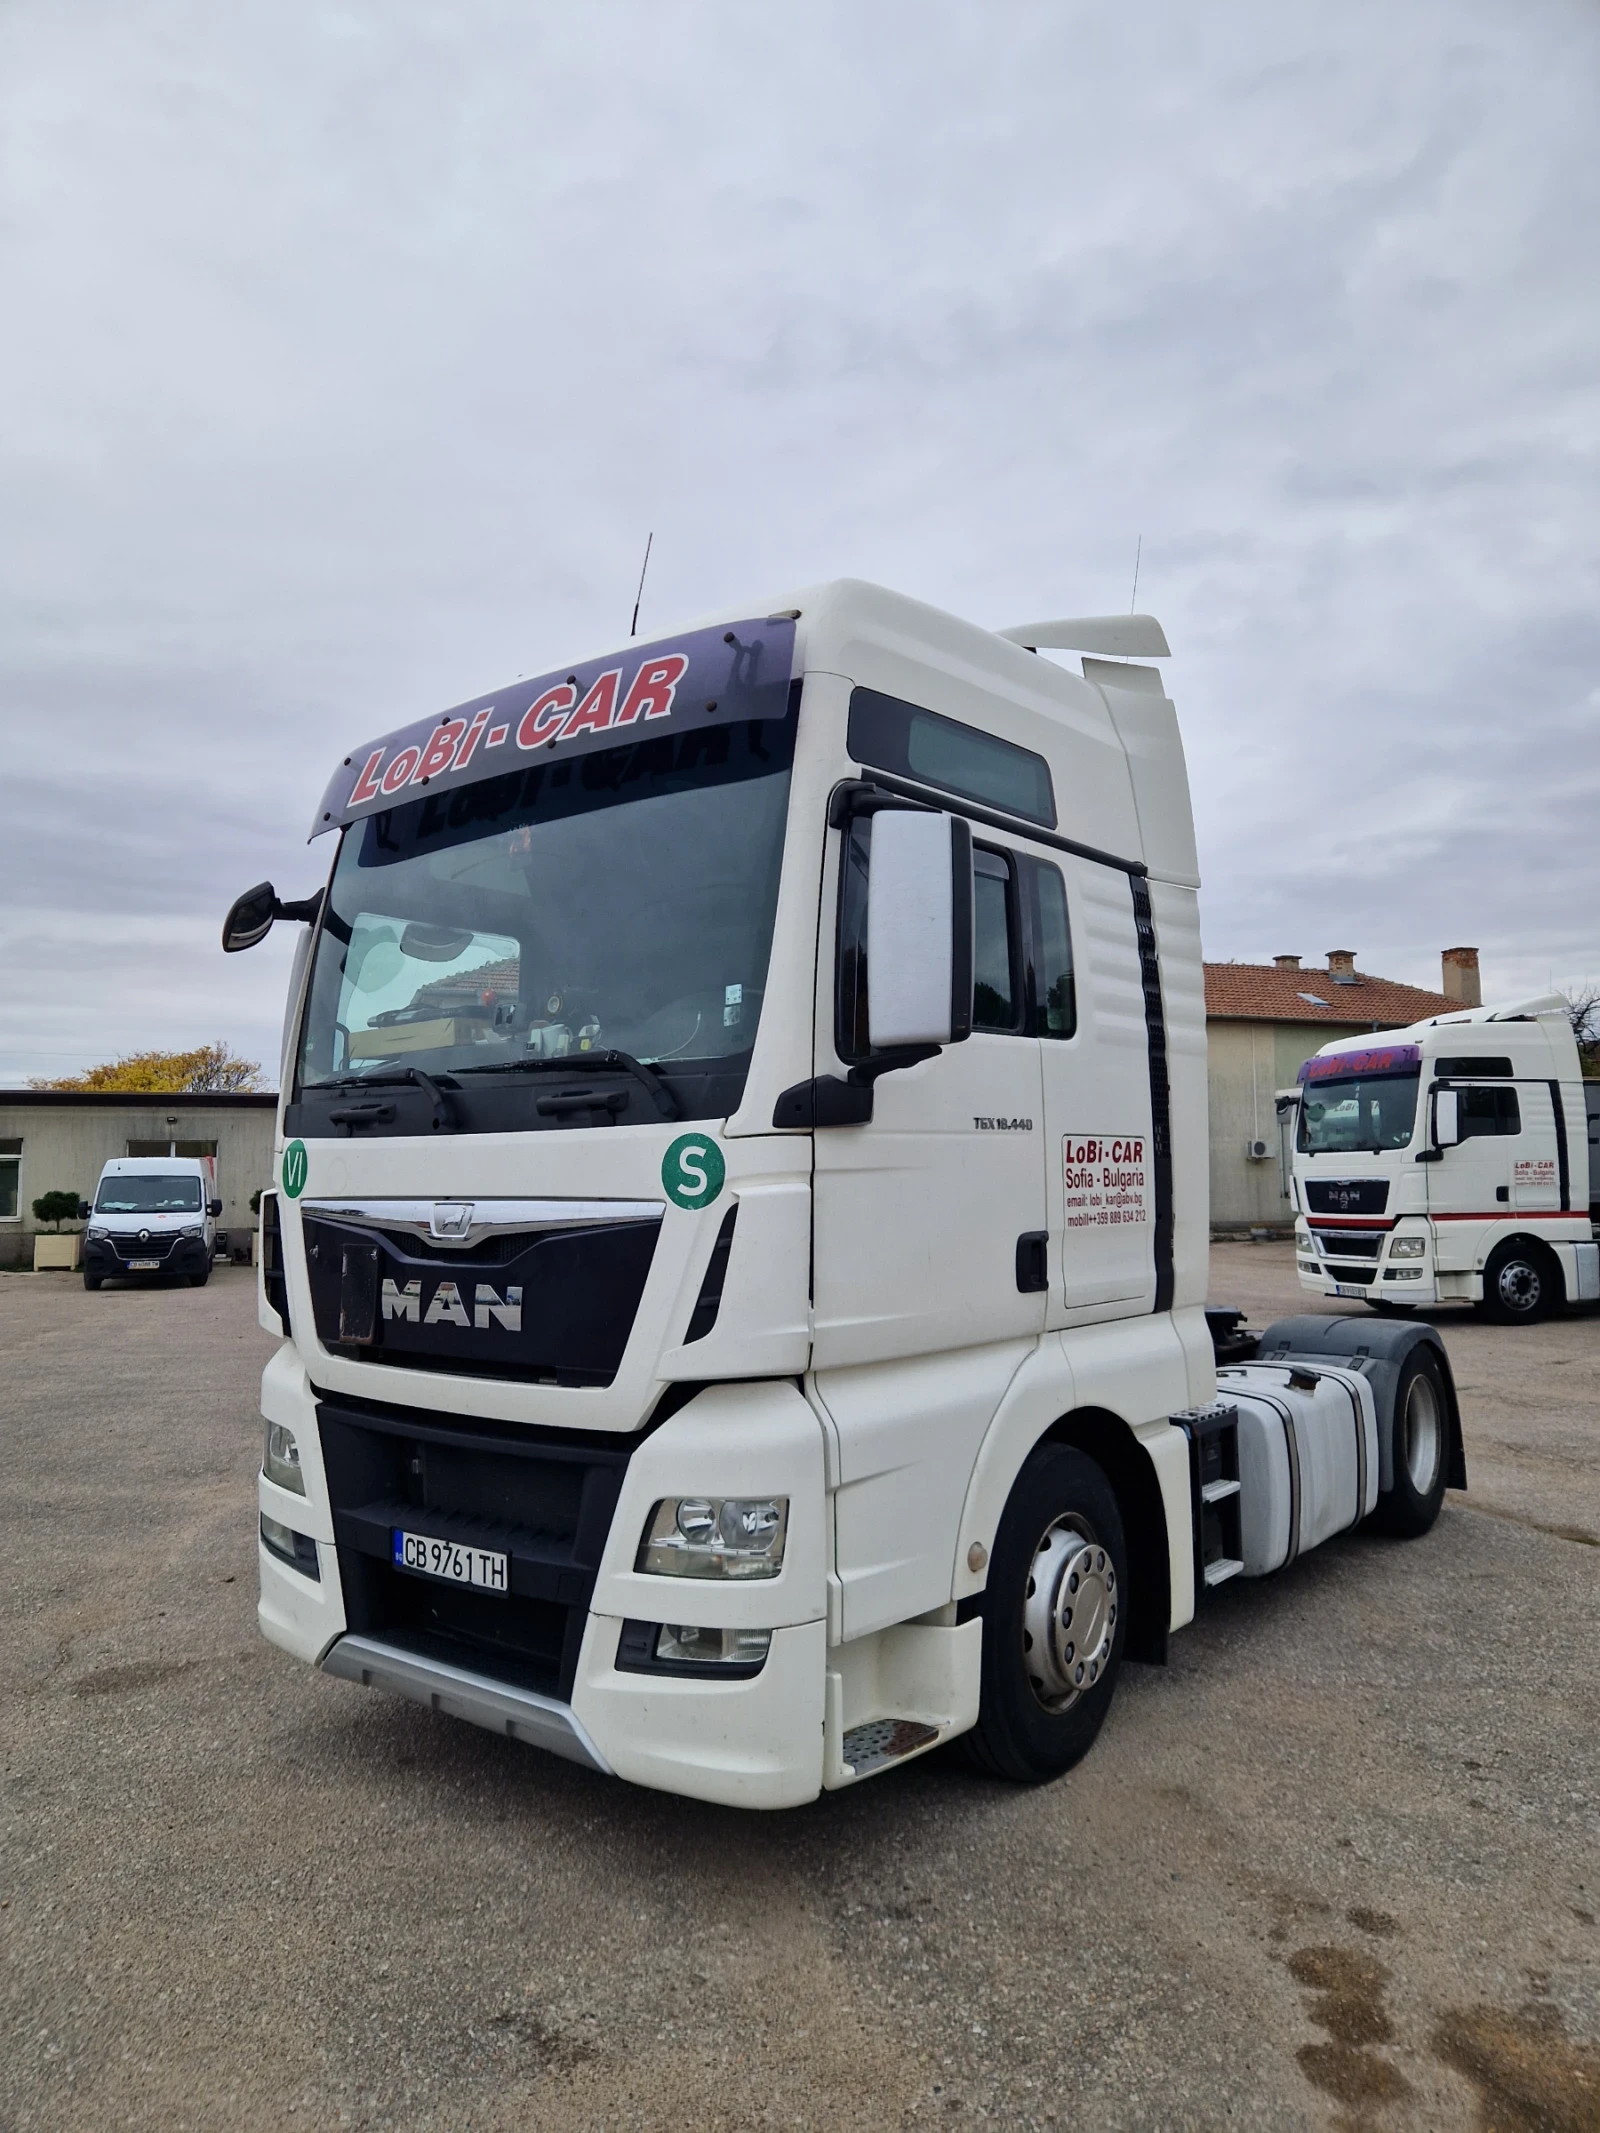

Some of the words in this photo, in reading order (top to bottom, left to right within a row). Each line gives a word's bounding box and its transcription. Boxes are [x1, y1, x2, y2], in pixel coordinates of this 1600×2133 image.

[996, 1117, 1033, 1131] 18.440
[676, 1146, 708, 1197] S
[1066, 1168, 1093, 1189] Sofia
[1103, 1167, 1144, 1192] Bulgaria
[1067, 1193, 1088, 1207] email:
[1089, 1191, 1142, 1209] lobi_kar@abv.bg
[1328, 1190, 1360, 1201] MAN
[1110, 1211, 1121, 1224] 889
[1122, 1210, 1134, 1223] 634
[1135, 1209, 1146, 1222] 212
[381, 1278, 523, 1332] MAN
